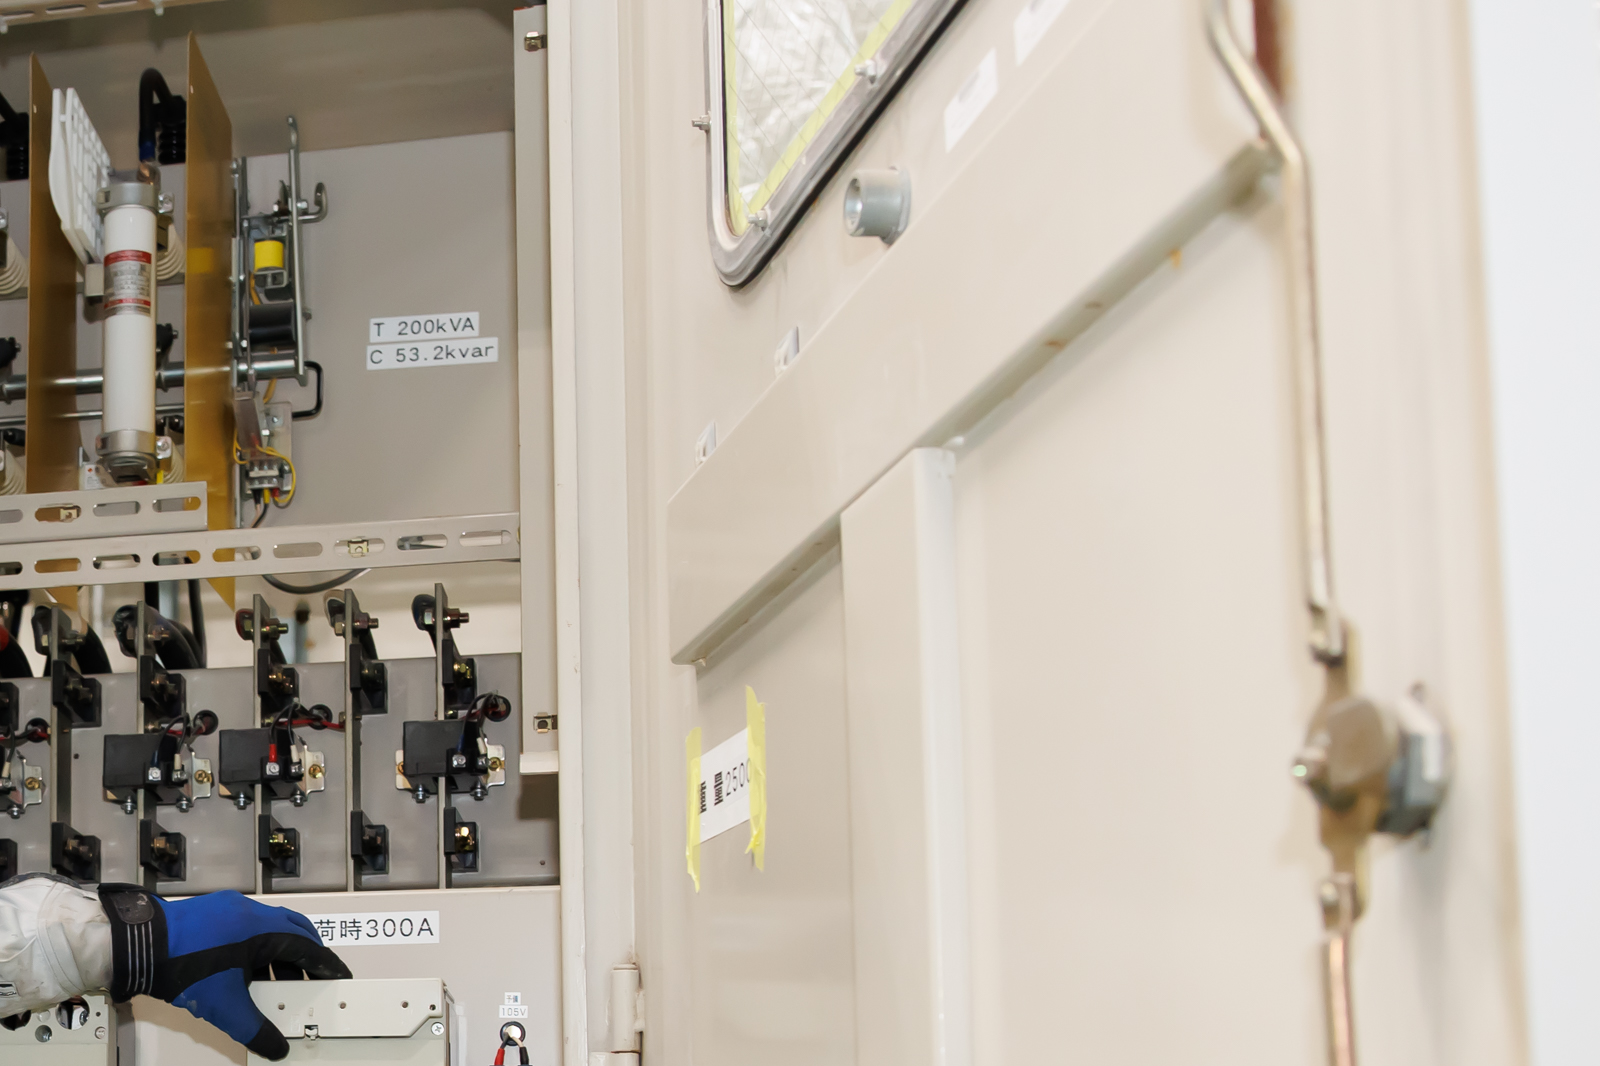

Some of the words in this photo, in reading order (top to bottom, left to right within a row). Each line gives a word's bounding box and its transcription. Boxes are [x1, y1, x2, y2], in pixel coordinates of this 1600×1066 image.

[373, 322, 385, 337] T
[398, 317, 475, 336] 200kVA
[370, 349, 383, 365] C
[395, 345, 495, 363] 53.2kvar
[314, 917, 434, 941] 荷時300A
[501, 1007, 526, 1017] 105V
